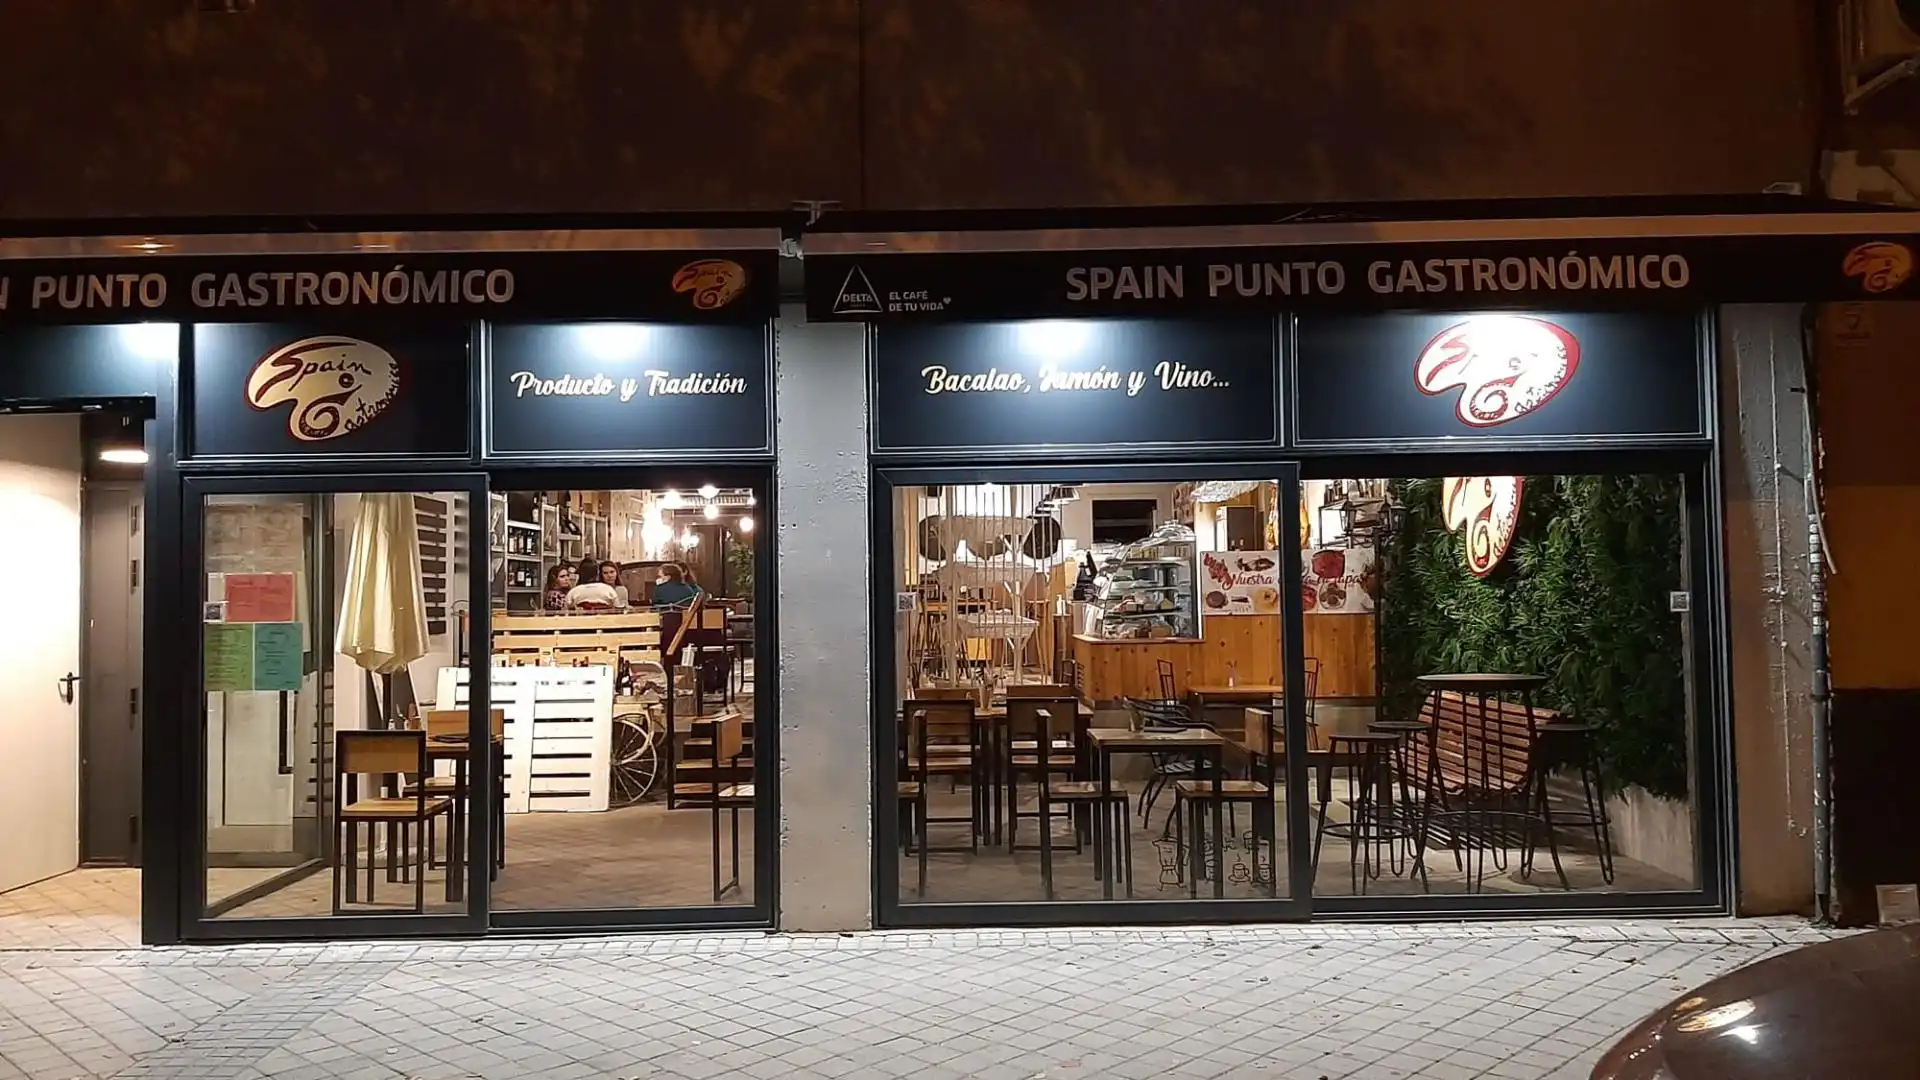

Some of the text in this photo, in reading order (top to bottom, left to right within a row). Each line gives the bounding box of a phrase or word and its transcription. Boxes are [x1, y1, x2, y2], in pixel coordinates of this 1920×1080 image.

[32, 273, 167, 309] PUNTO
[191, 264, 515, 307] GASTRONÓMICO
[1066, 250, 1690, 300] SPAIN PUNTO GASTRONÓMICO
[842, 293, 873, 303] DELTA
[889, 290, 928, 300] EL CAFÉ
[889, 302, 944, 312] DE TU VIDA
[255, 341, 372, 404] Spain
[510, 369, 748, 402] Producto y Tradición
[921, 365, 1032, 394] Bacalao,
[1038, 362, 1122, 392] Jamón
[1126, 370, 1147, 397] y
